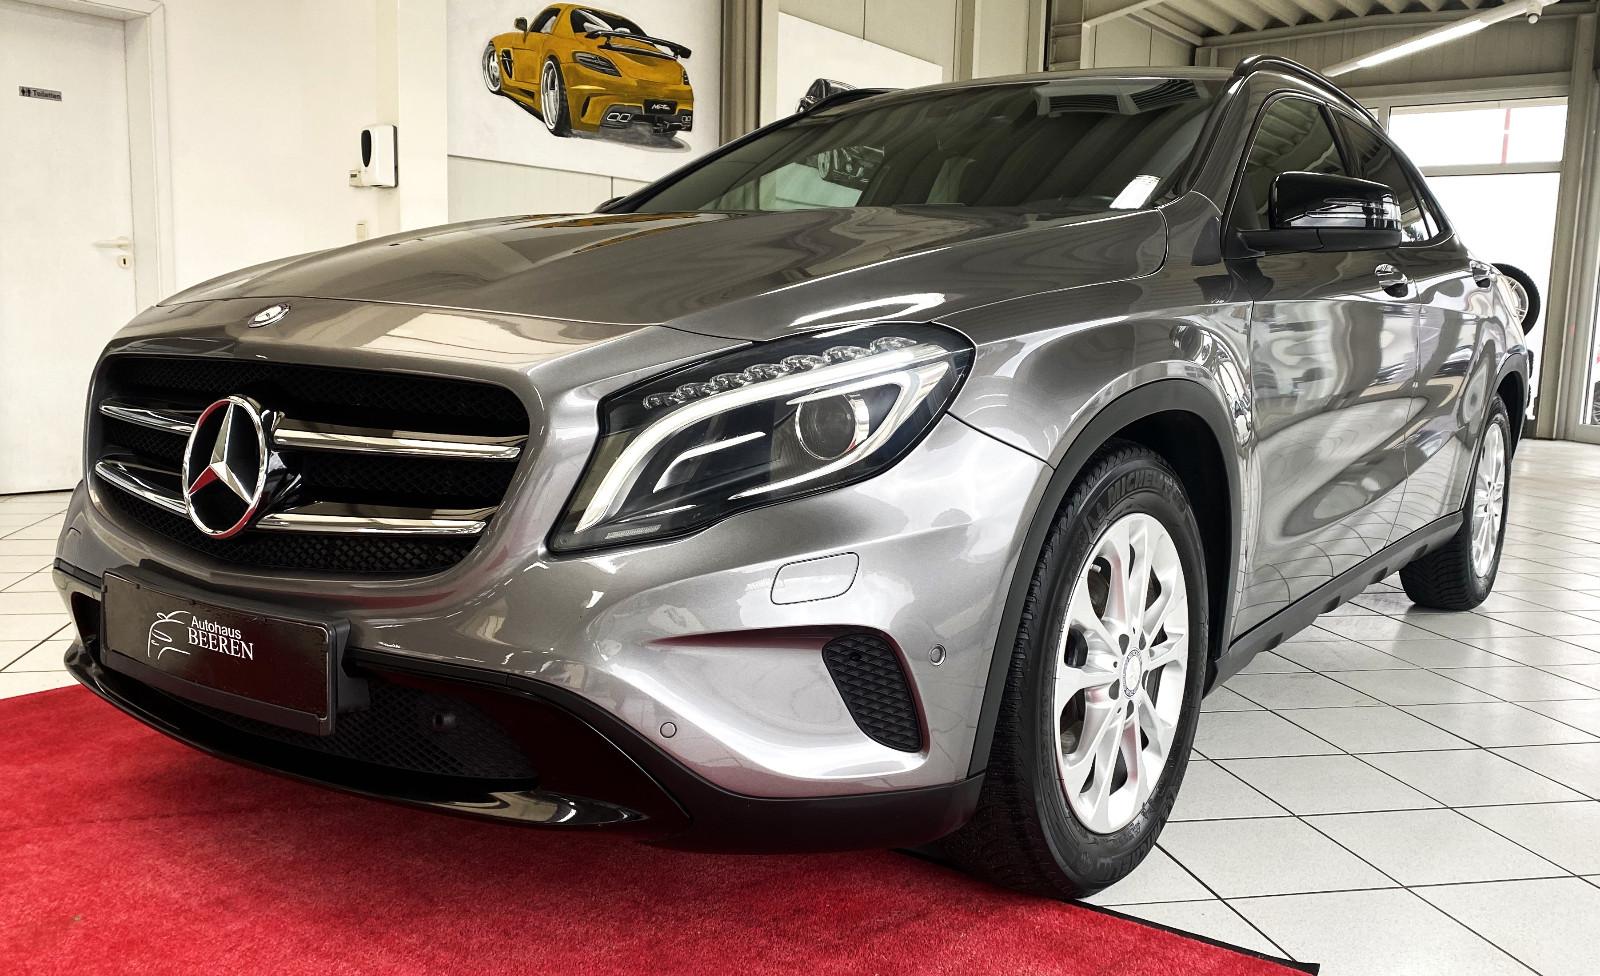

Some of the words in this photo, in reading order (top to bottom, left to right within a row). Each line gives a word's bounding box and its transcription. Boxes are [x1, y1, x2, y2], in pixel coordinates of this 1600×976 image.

[32, 89, 61, 99] Toiletten
[191, 615, 242, 639] Autohaus
[187, 626, 254, 660] BEEREN
